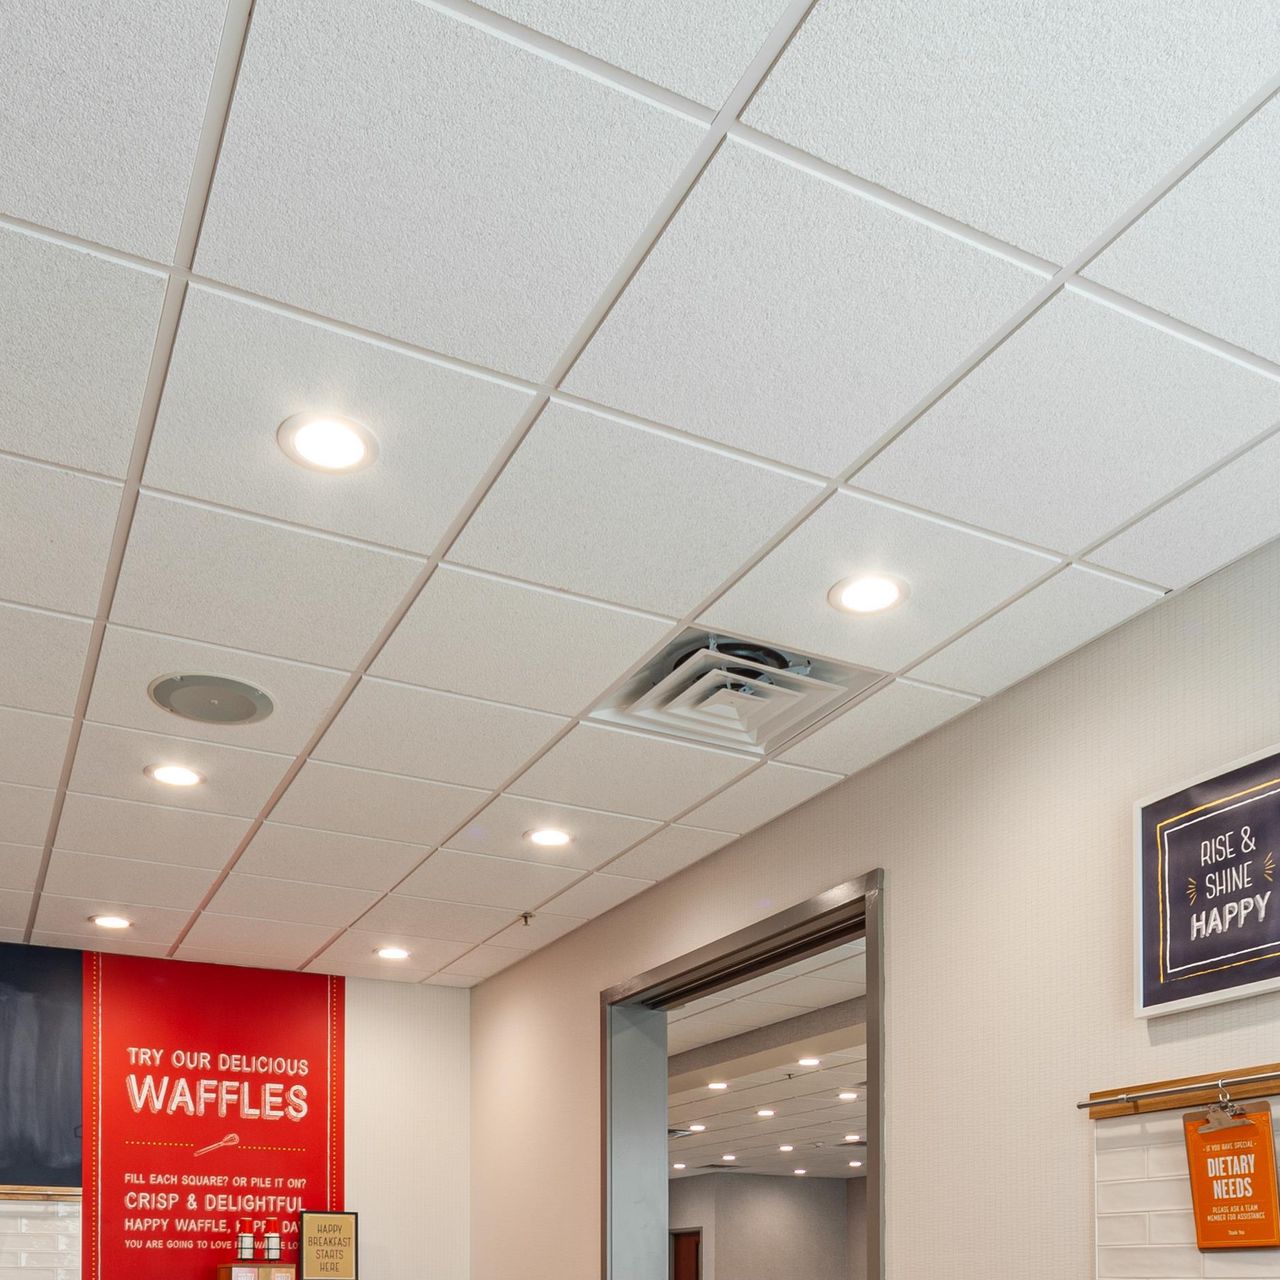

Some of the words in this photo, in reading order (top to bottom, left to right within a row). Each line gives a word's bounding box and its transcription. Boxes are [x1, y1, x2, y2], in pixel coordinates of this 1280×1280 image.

[1201, 831, 1236, 867] RISE
[1240, 826, 1256, 853] &
[1205, 861, 1253, 899] SHINE
[1190, 891, 1271, 941] HAPPY
[126, 1047, 164, 1066] TRY
[171, 1050, 211, 1071] OUR
[218, 1053, 309, 1077] DELICIOUS
[125, 1074, 308, 1122] WAFFLES
[1207, 1154, 1255, 1177] DIETARY
[124, 1173, 145, 1184] FILL
[149, 1174, 178, 1185] EACH
[181, 1175, 228, 1187] SQUARE?
[232, 1177, 247, 1187] OR
[251, 1177, 271, 1188] PILE
[275, 1178, 284, 1188] IT
[287, 1178, 307, 1189] ON?
[1213, 1177, 1253, 1199] NEEDS
[124, 1192, 179, 1210] CRISP
[187, 1193, 197, 1211] &
[205, 1194, 306, 1213] DELIGHTFUL
[124, 1218, 169, 1231] HAPPY
[175, 1219, 231, 1233] WAFFLE,
[282, 1220, 300, 1233] DA
[317, 1224, 342, 1234] HAPPY
[124, 1240, 143, 1248] YOU
[145, 1240, 164, 1249] ARE
[166, 1240, 194, 1249] GOING
[197, 1240, 208, 1249] TO
[210, 1240, 232, 1249] LOVE
[308, 1236, 351, 1247] BREAKFAST
[315, 1249, 344, 1259] STARTS
[320, 1262, 340, 1272] HERE
